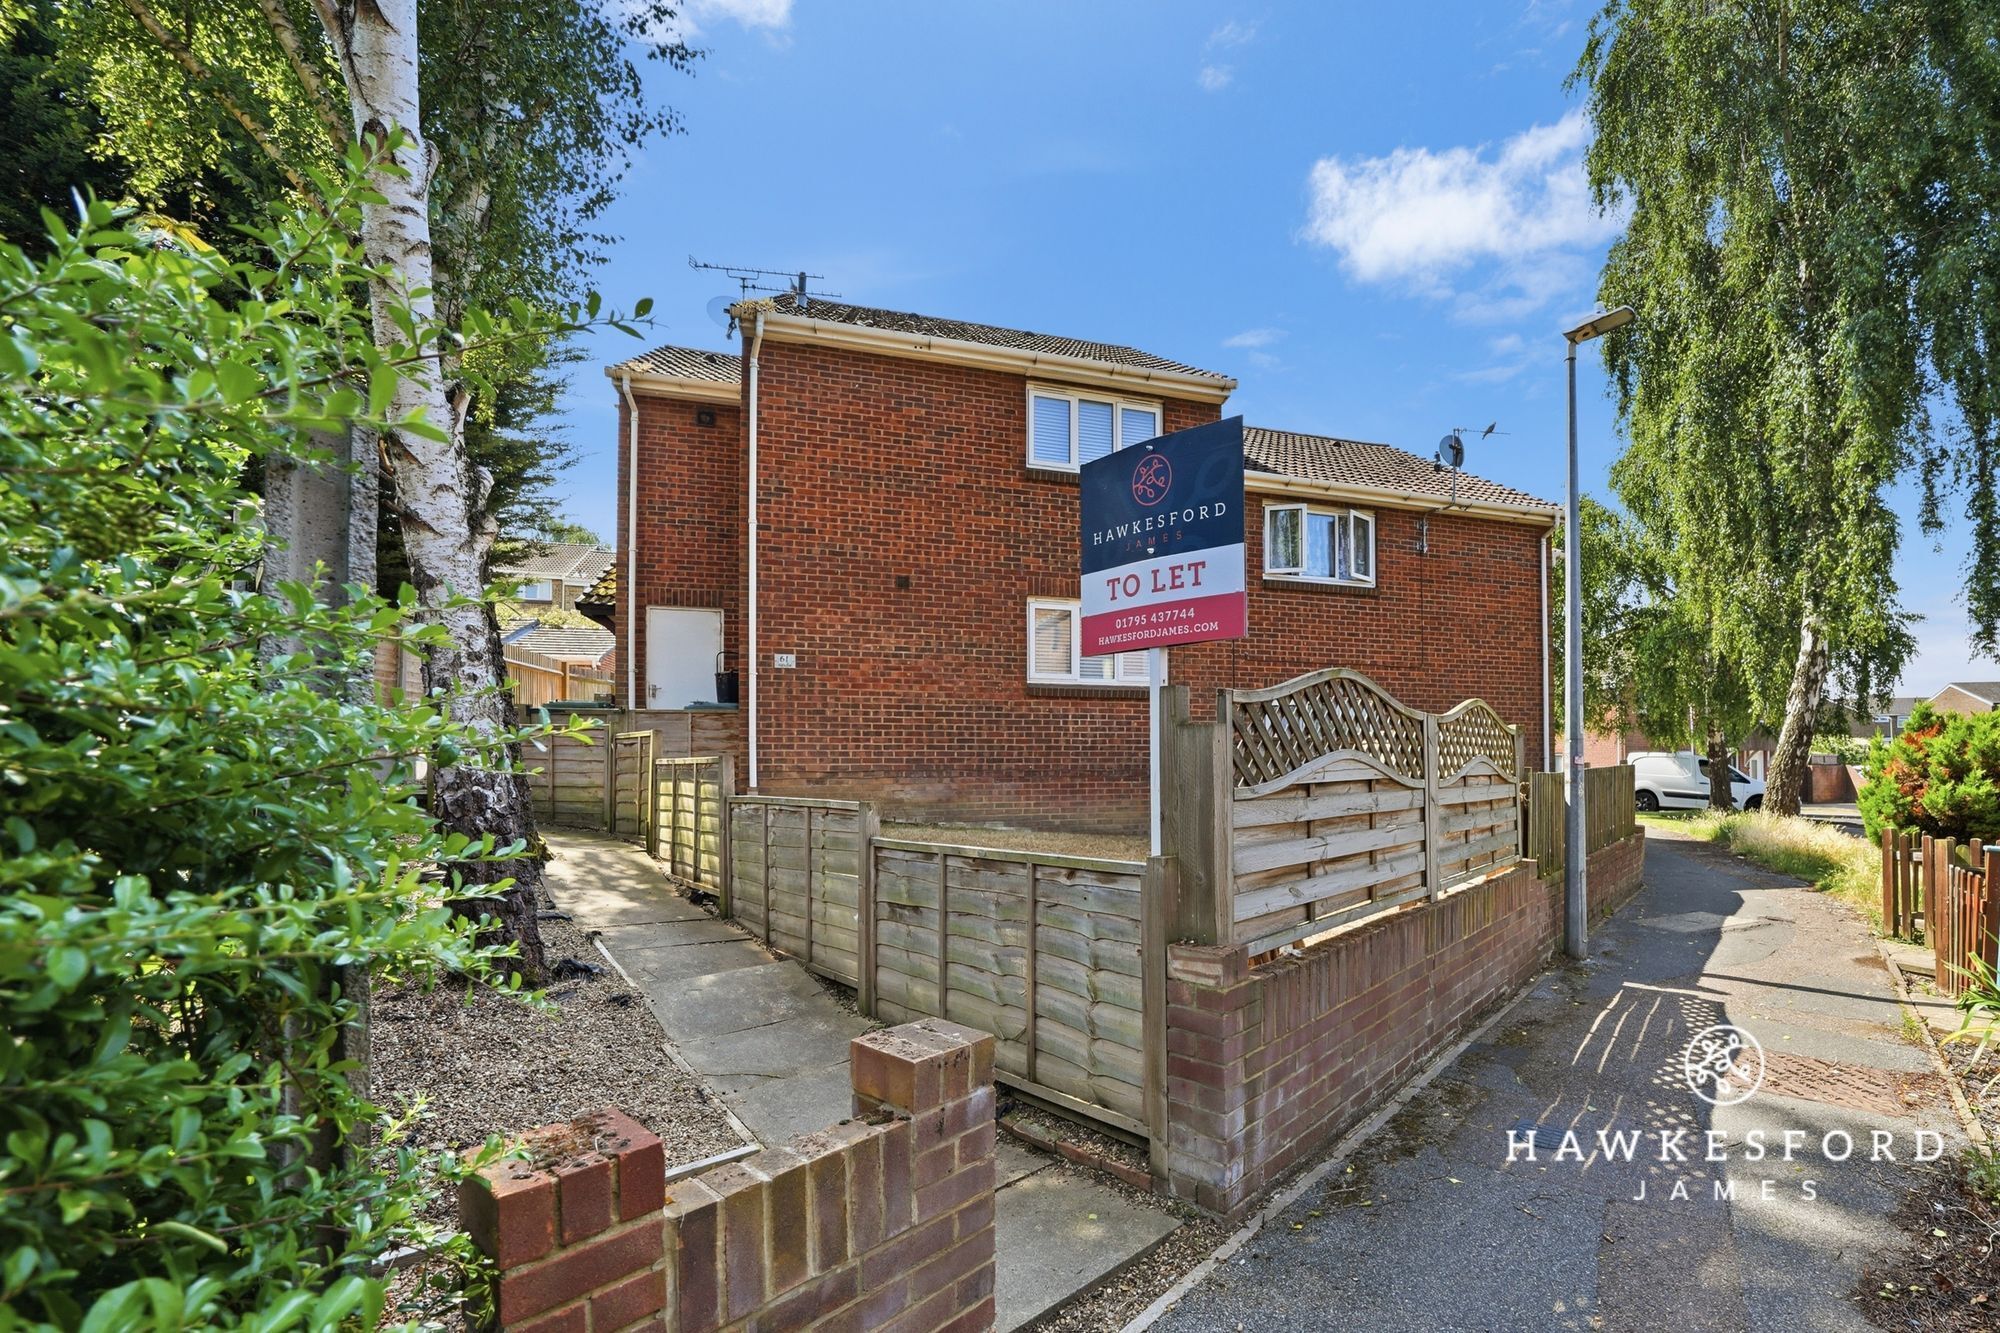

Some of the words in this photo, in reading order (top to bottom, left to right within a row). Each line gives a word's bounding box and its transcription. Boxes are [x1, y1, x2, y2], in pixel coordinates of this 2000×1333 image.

[1093, 502, 1227, 545] HAWKESFORD
[1125, 530, 1184, 552] JAMES
[1106, 573, 1141, 601] TO
[1151, 561, 1206, 593] LET
[1115, 614, 1147, 629] 01795
[1150, 607, 1195, 623] 437744
[1098, 621, 1219, 646] HAWKESFORDJAMES.COM
